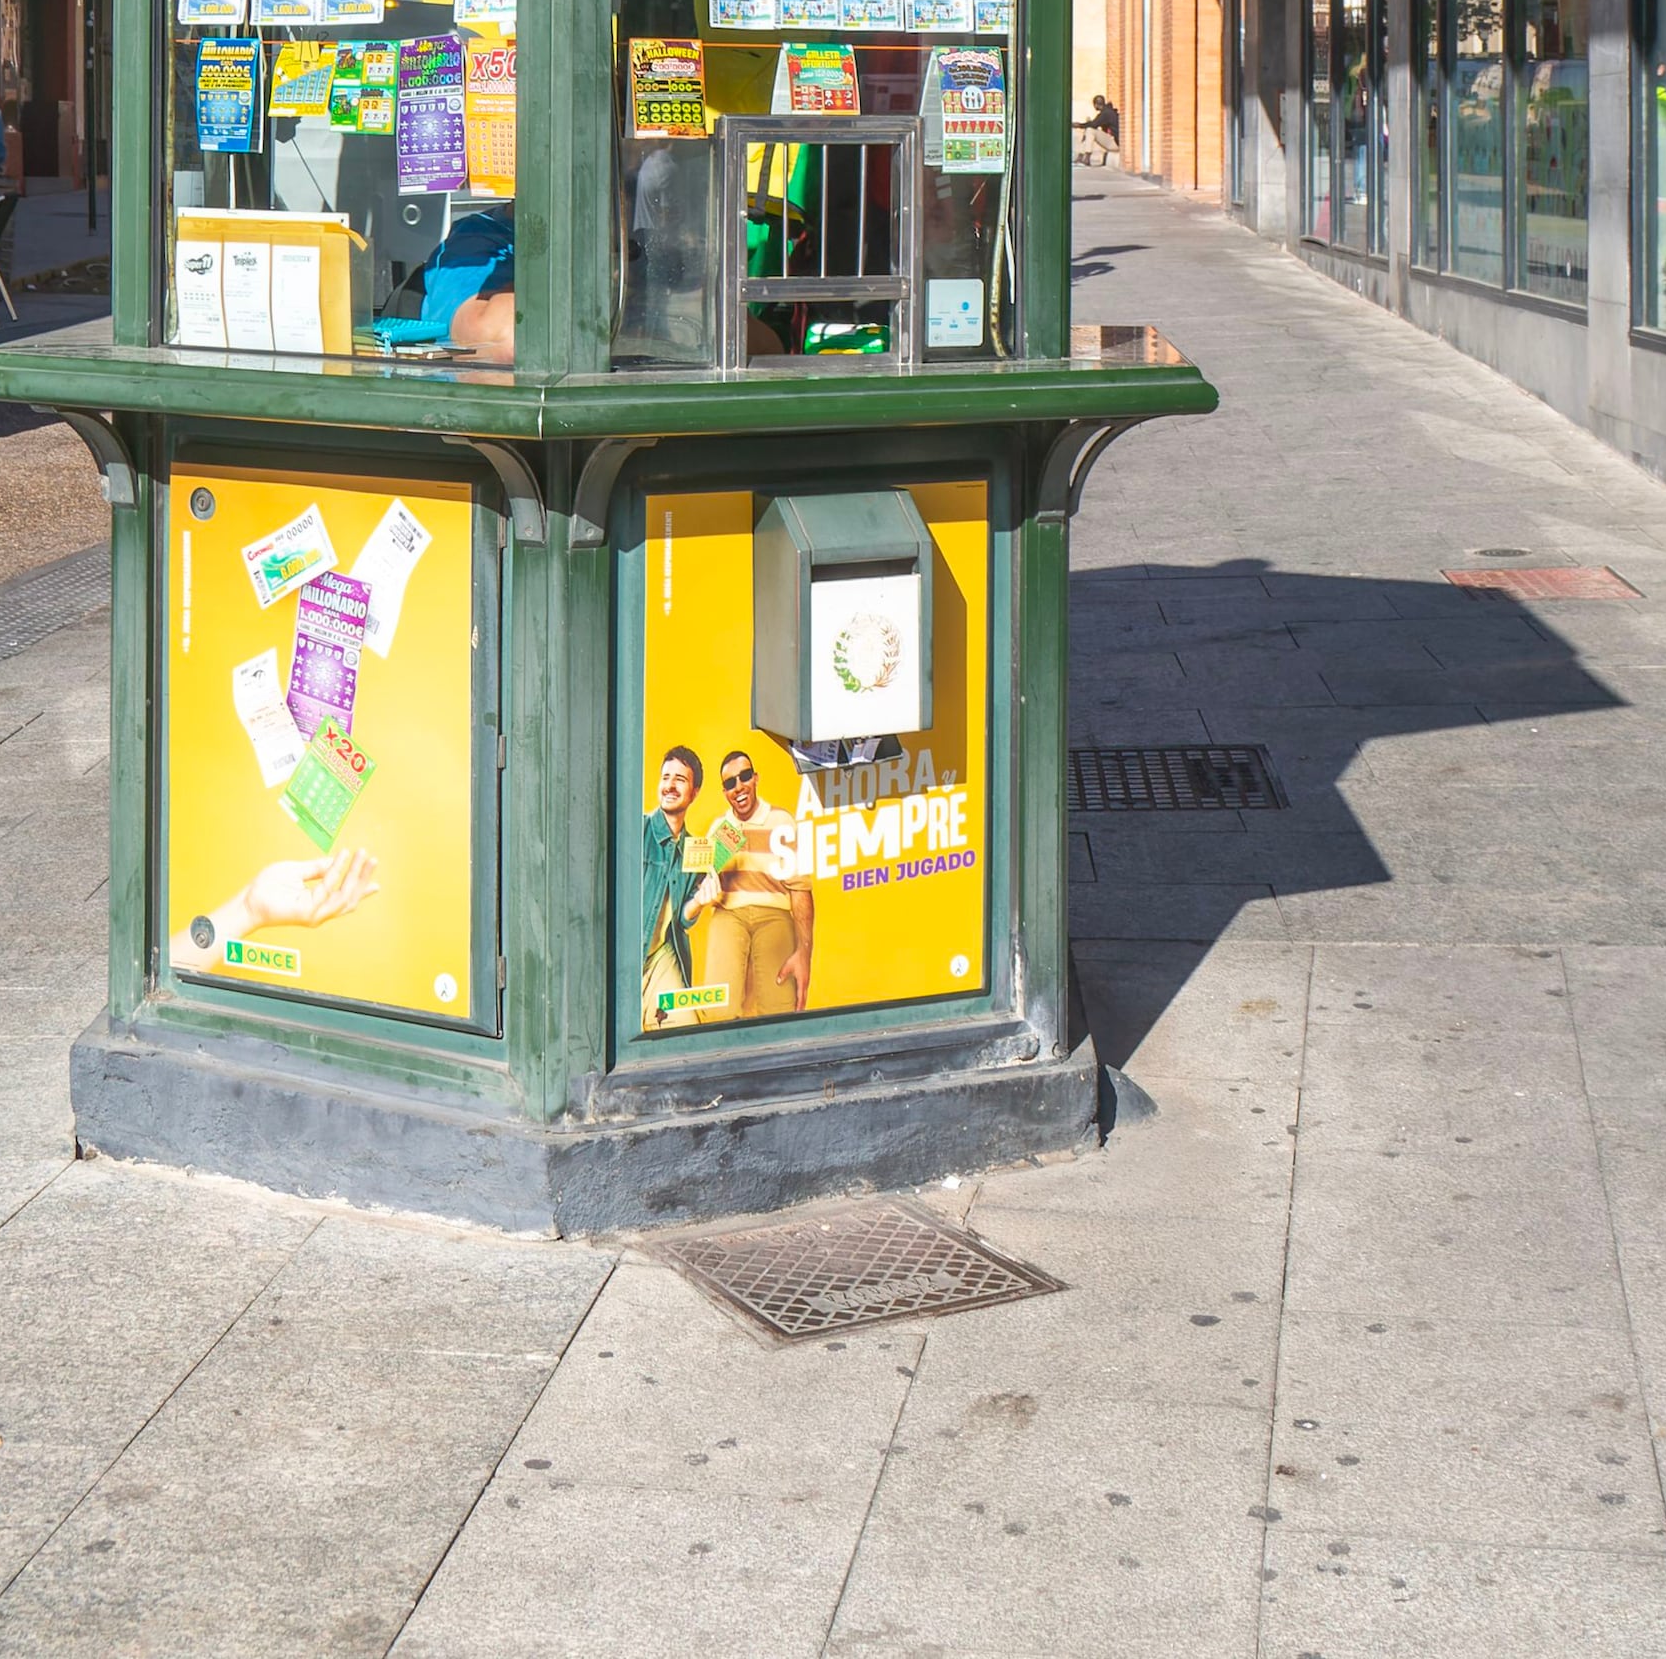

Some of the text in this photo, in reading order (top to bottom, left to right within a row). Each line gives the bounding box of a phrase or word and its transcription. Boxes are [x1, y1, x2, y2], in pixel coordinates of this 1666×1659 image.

[646, 46, 700, 60] HALLOWEEN
[321, 572, 351, 595] Mega
[301, 584, 368, 619] MILLONARIO
[299, 607, 364, 639] 1.000.000€
[324, 726, 367, 773] x20
[796, 748, 935, 821] AHORA
[769, 792, 968, 881] SIEMPRE
[843, 850, 976, 892] BIEN JUGADO
[247, 948, 294, 970] ONCE
[678, 989, 724, 1007] ONCE
